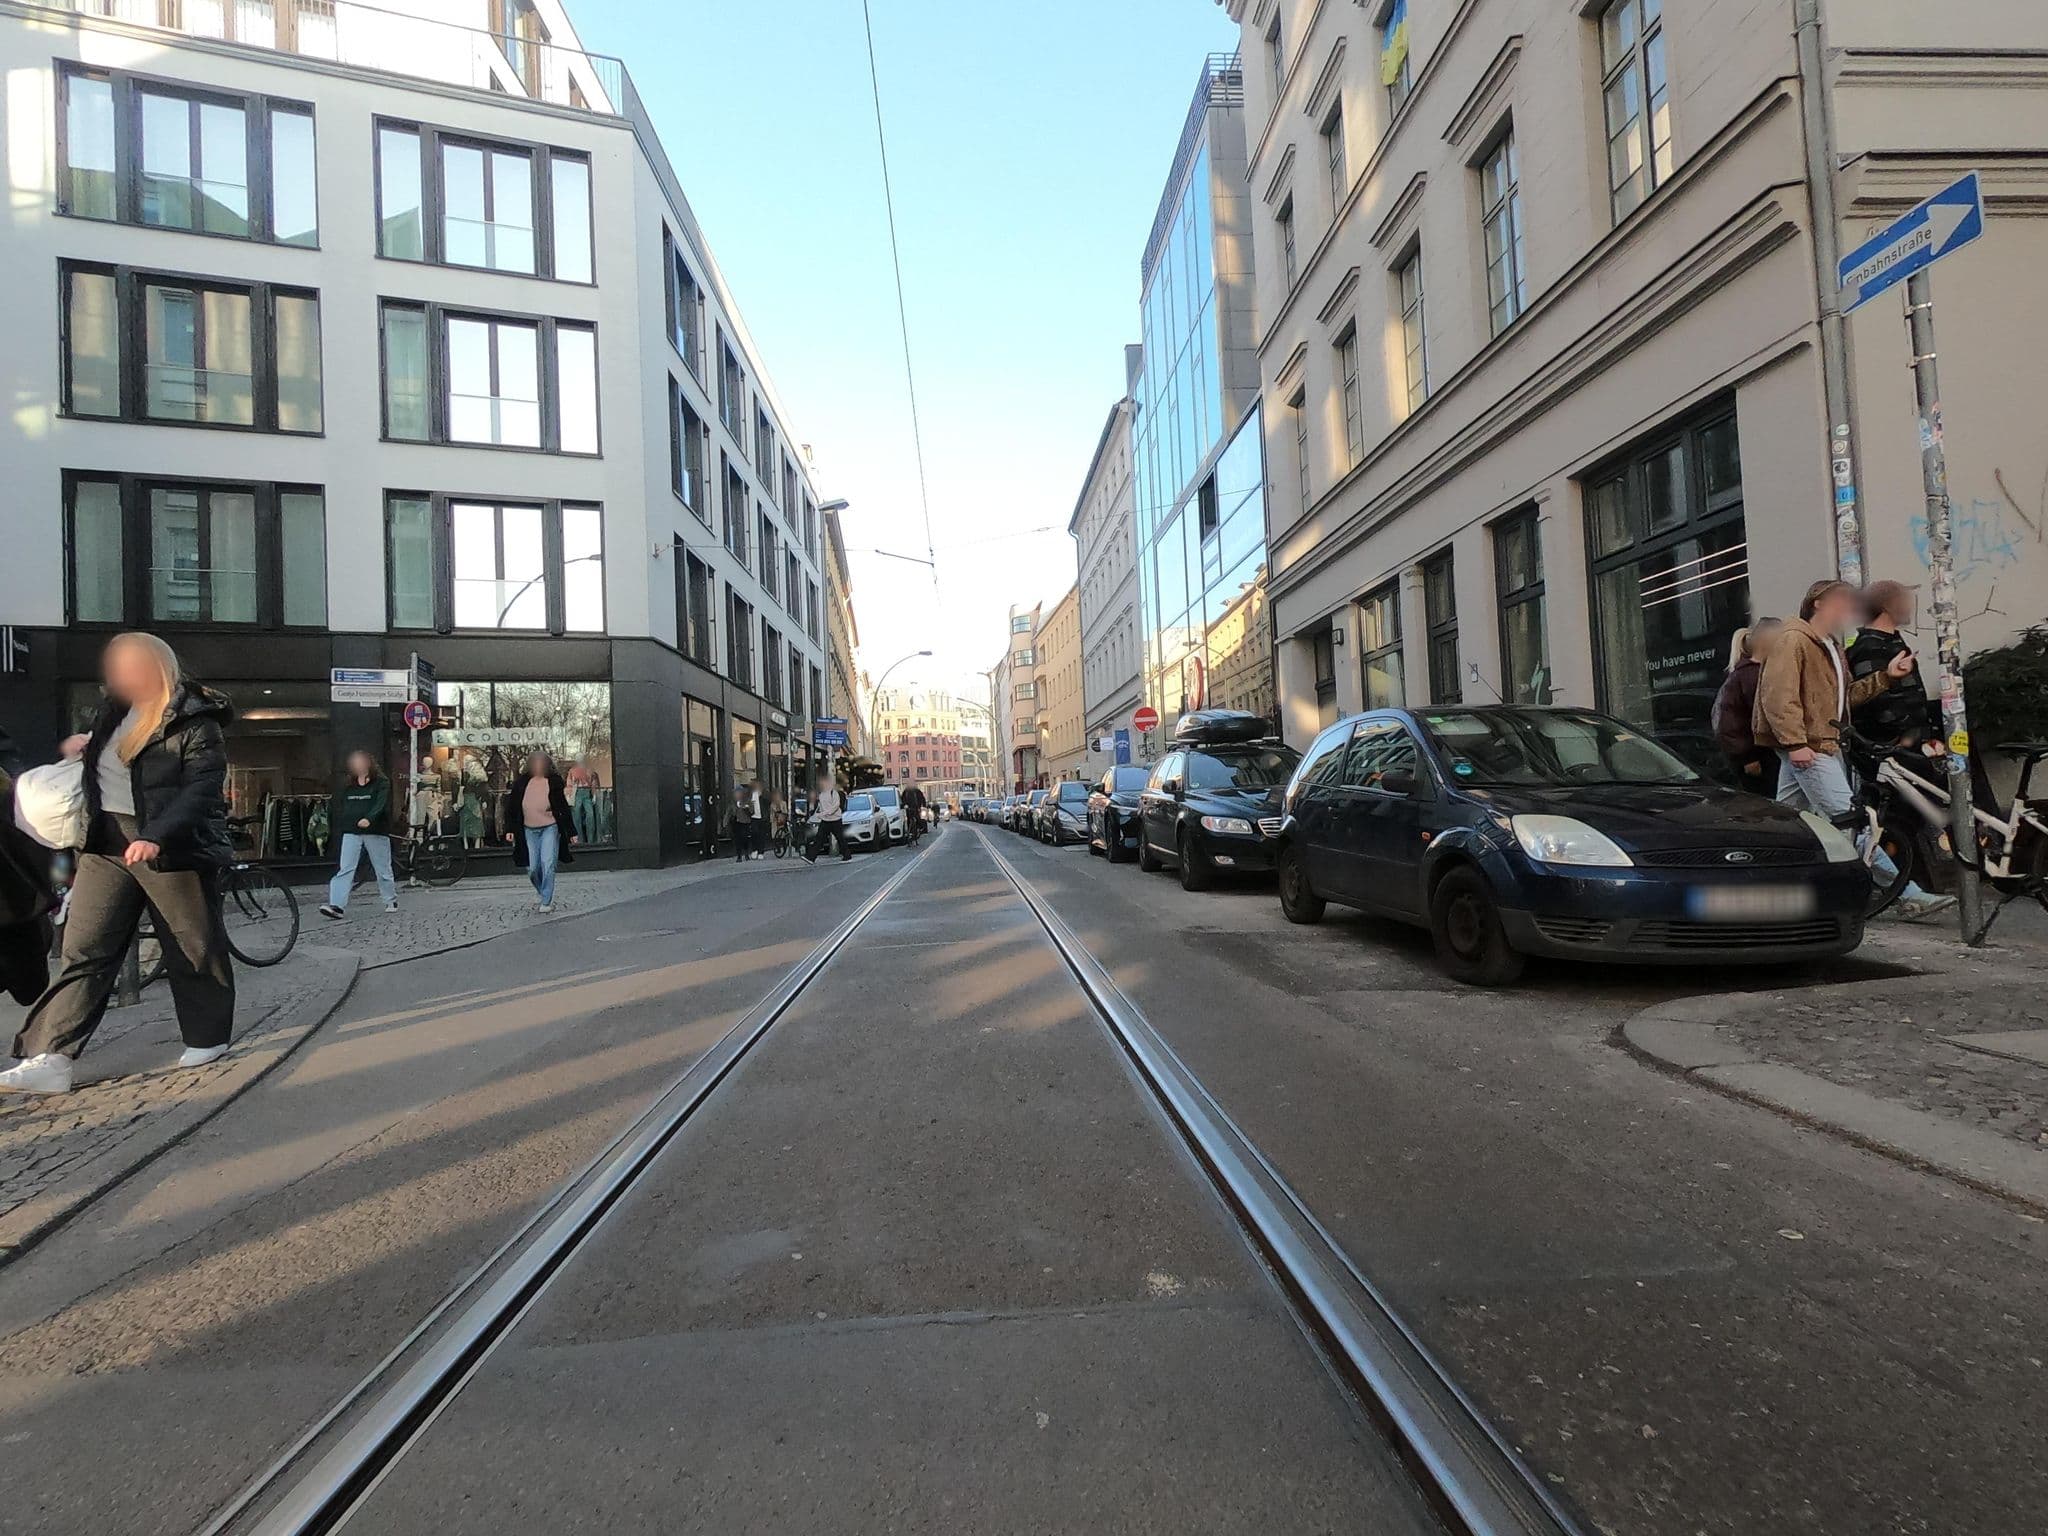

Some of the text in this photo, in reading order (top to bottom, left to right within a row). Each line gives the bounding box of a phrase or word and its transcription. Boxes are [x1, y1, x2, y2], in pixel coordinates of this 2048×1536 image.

[1846, 228, 1932, 284] Enbahnstraße
[1644, 649, 1716, 671] You have never
